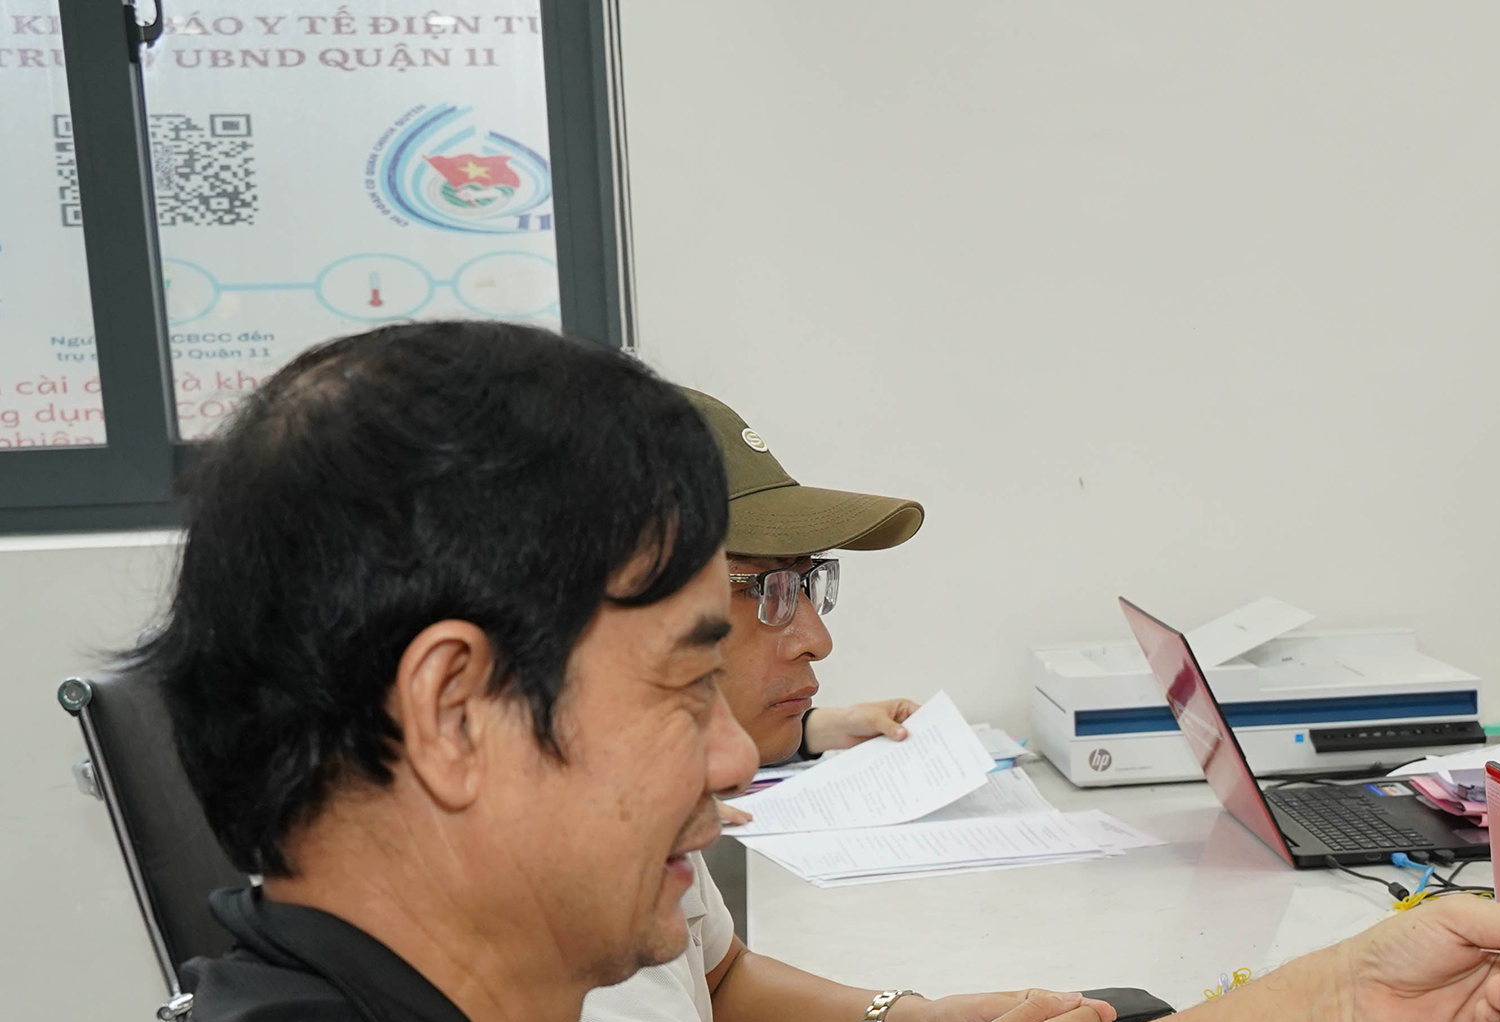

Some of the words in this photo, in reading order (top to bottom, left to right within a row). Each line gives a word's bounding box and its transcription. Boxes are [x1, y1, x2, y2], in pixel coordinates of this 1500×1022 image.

[255, 16, 286, 36] Y
[298, 5, 357, 36] TẾ
[369, 10, 482, 40] ĐIỆN
[171, 48, 306, 69] UBND
[318, 42, 452, 72] QUẬN
[188, 347, 242, 363] Quận
[16, 375, 68, 396] cài
[1090, 748, 1112, 772] hp
